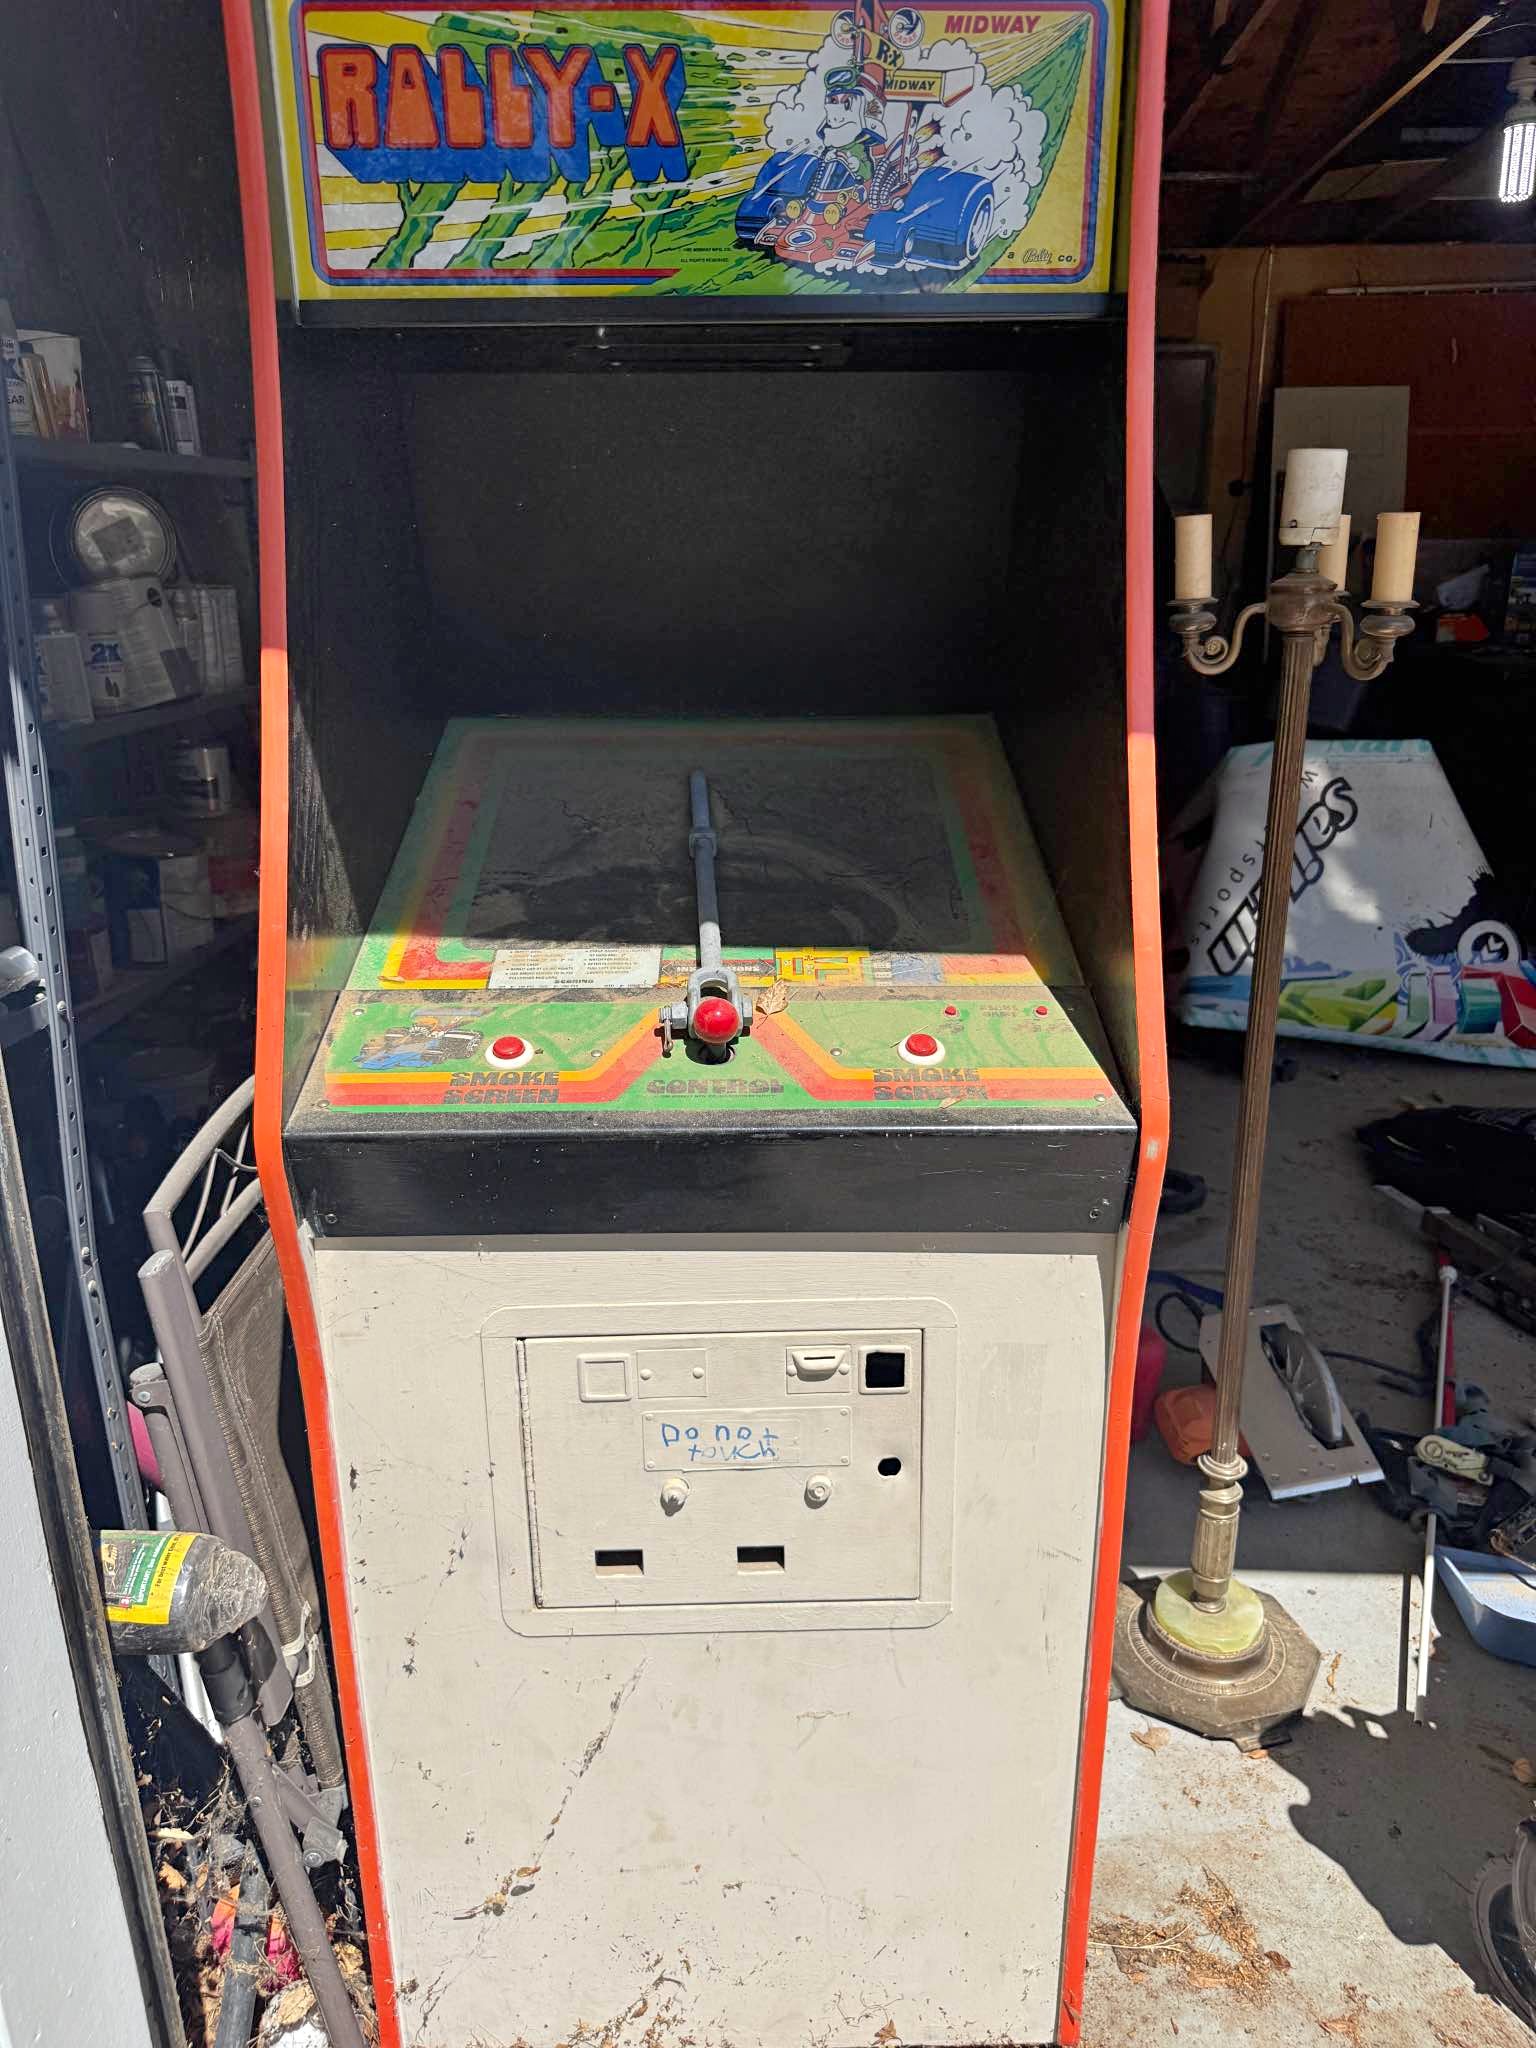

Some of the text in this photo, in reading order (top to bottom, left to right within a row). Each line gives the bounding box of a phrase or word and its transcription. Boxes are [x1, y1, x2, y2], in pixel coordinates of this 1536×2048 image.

[944, 15, 1041, 34] MIDWAY
[884, 79, 936, 92] MIDWAY
[318, 44, 688, 158] RALLY-X
[1007, 251, 1015, 259] a
[1057, 254, 1077, 263] co.
[450, 1071, 560, 1087] SMOKE
[873, 1068, 980, 1083] SMOKE
[646, 1079, 785, 1094] CONTROL
[443, 1088, 560, 1104] SCREEN
[715, 1424, 779, 1446] not
[688, 1440, 777, 1461] touch
